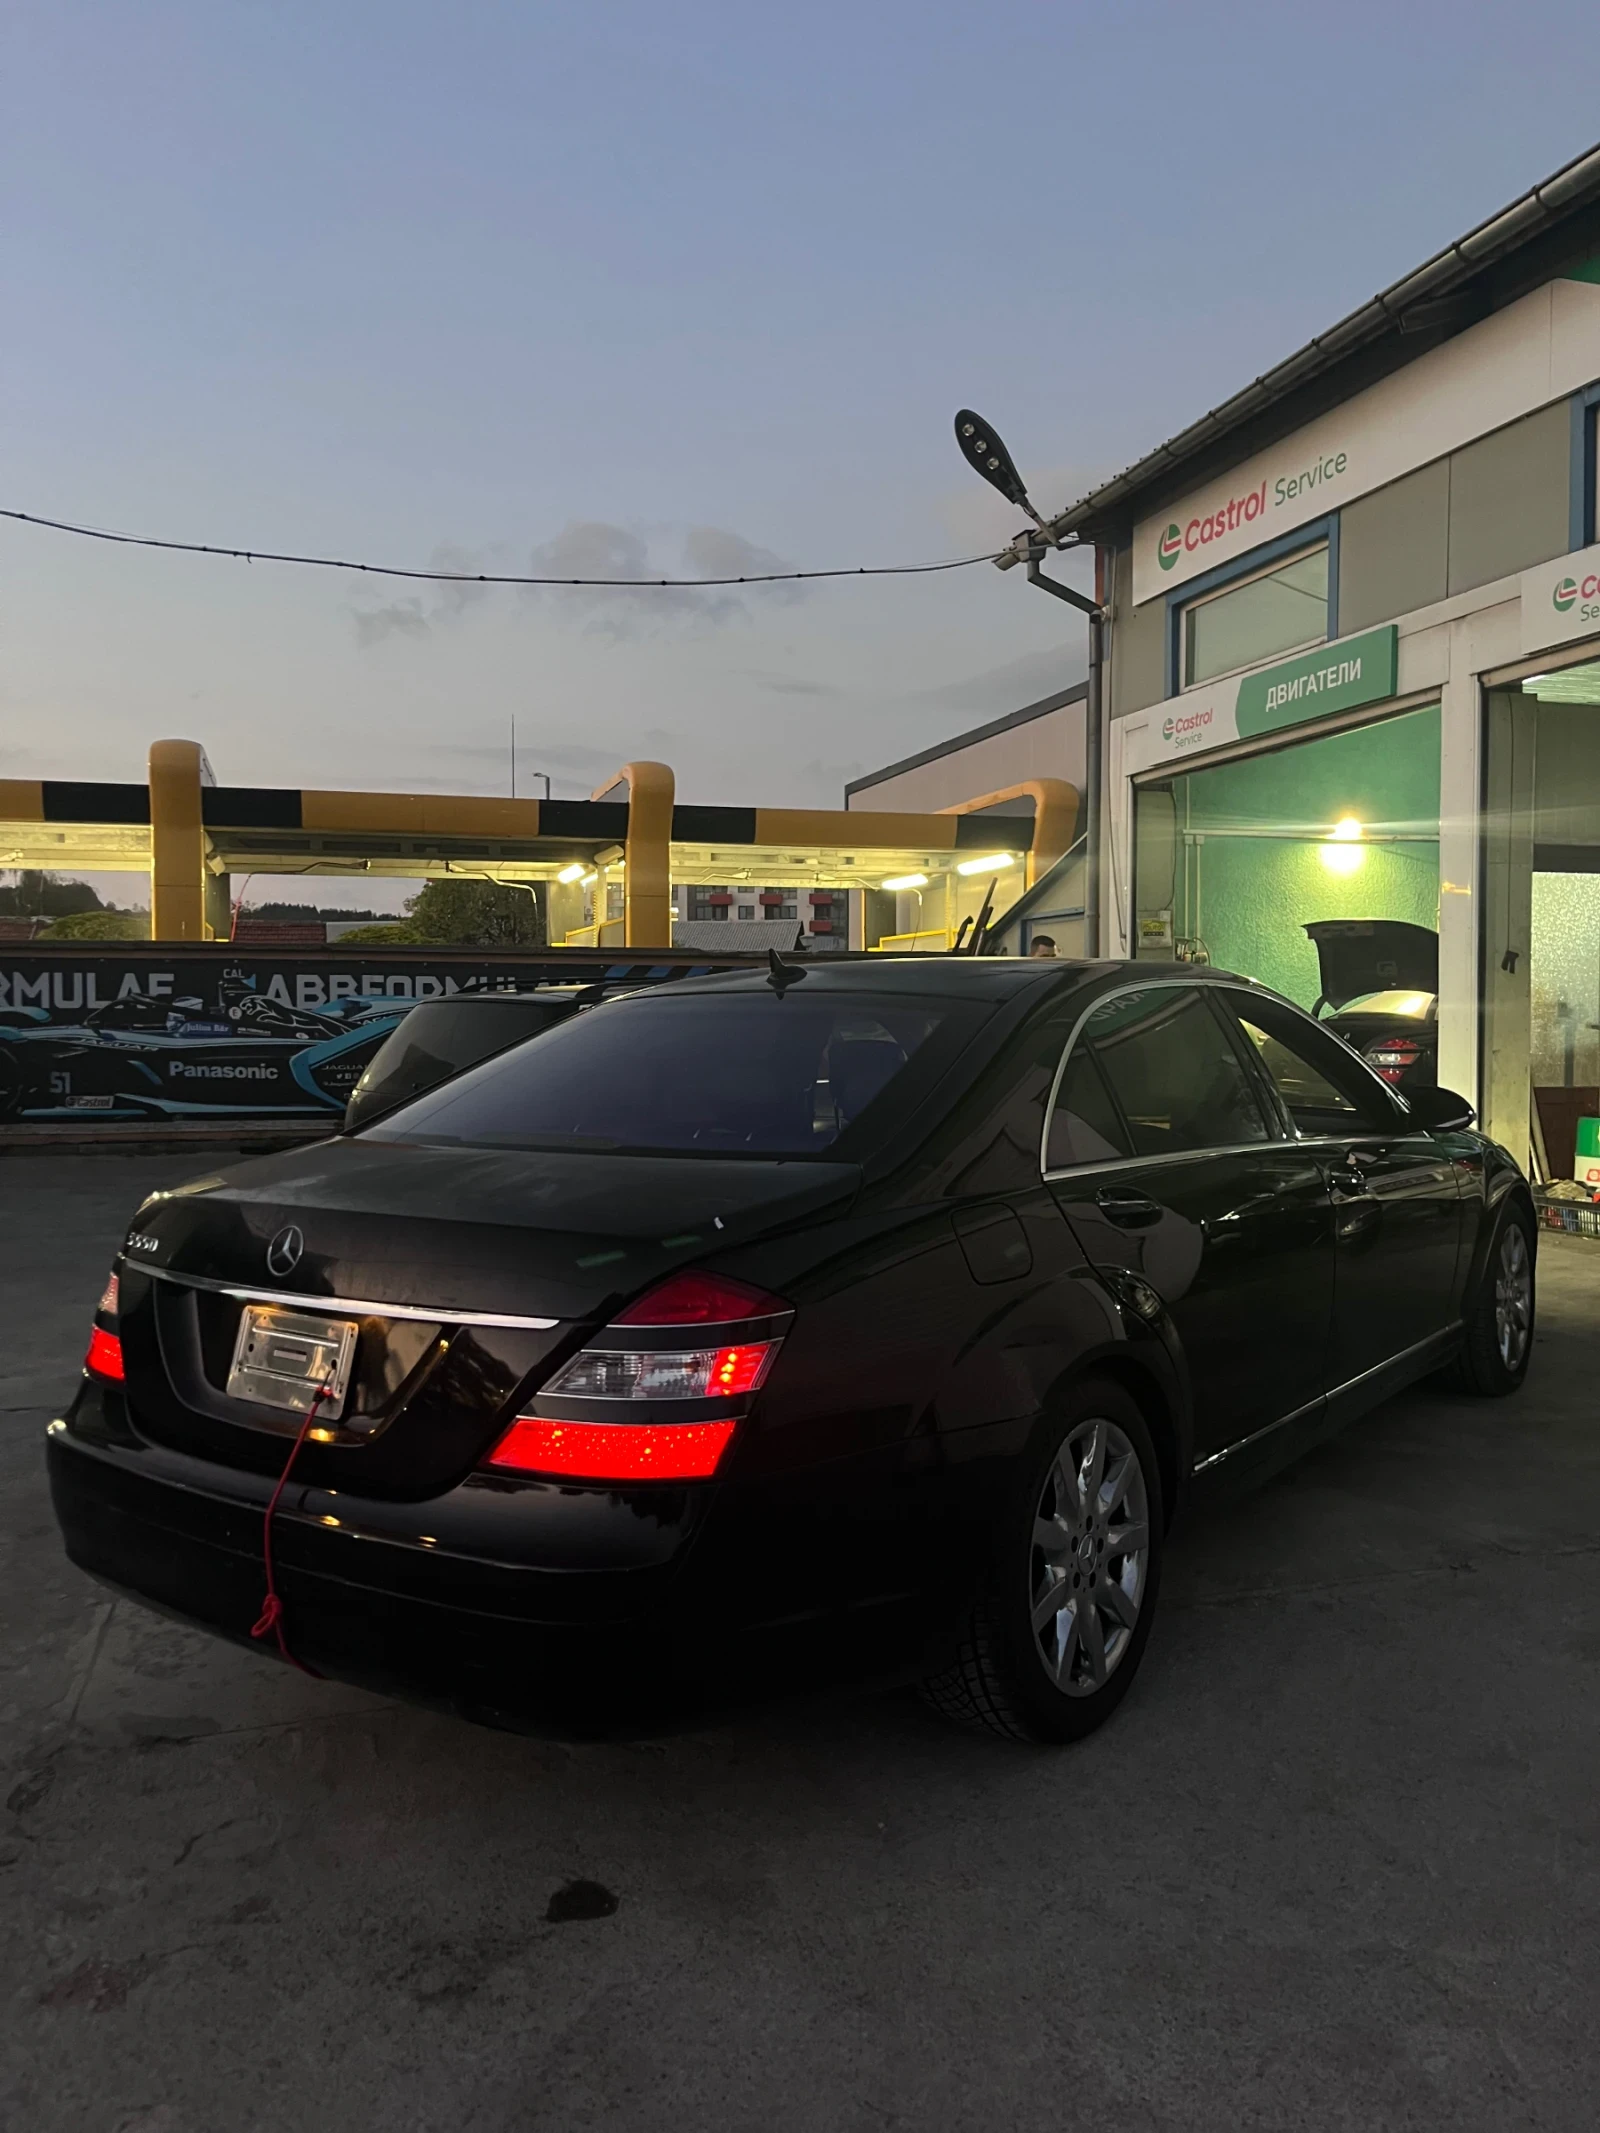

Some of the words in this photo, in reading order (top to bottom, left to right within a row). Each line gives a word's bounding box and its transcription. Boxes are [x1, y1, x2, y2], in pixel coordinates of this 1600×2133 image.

[1185, 480, 1267, 551] Castrol
[1275, 452, 1347, 507] Service
[1581, 575, 1600, 599] C
[1265, 658, 1361, 712] ДВИГАТЕЛИ
[1175, 708, 1213, 734] Castrol
[1174, 731, 1203, 749] Service
[169, 1061, 279, 1079] Panasonic
[50, 1071, 71, 1094] 51
[126, 1231, 159, 1253] S550
